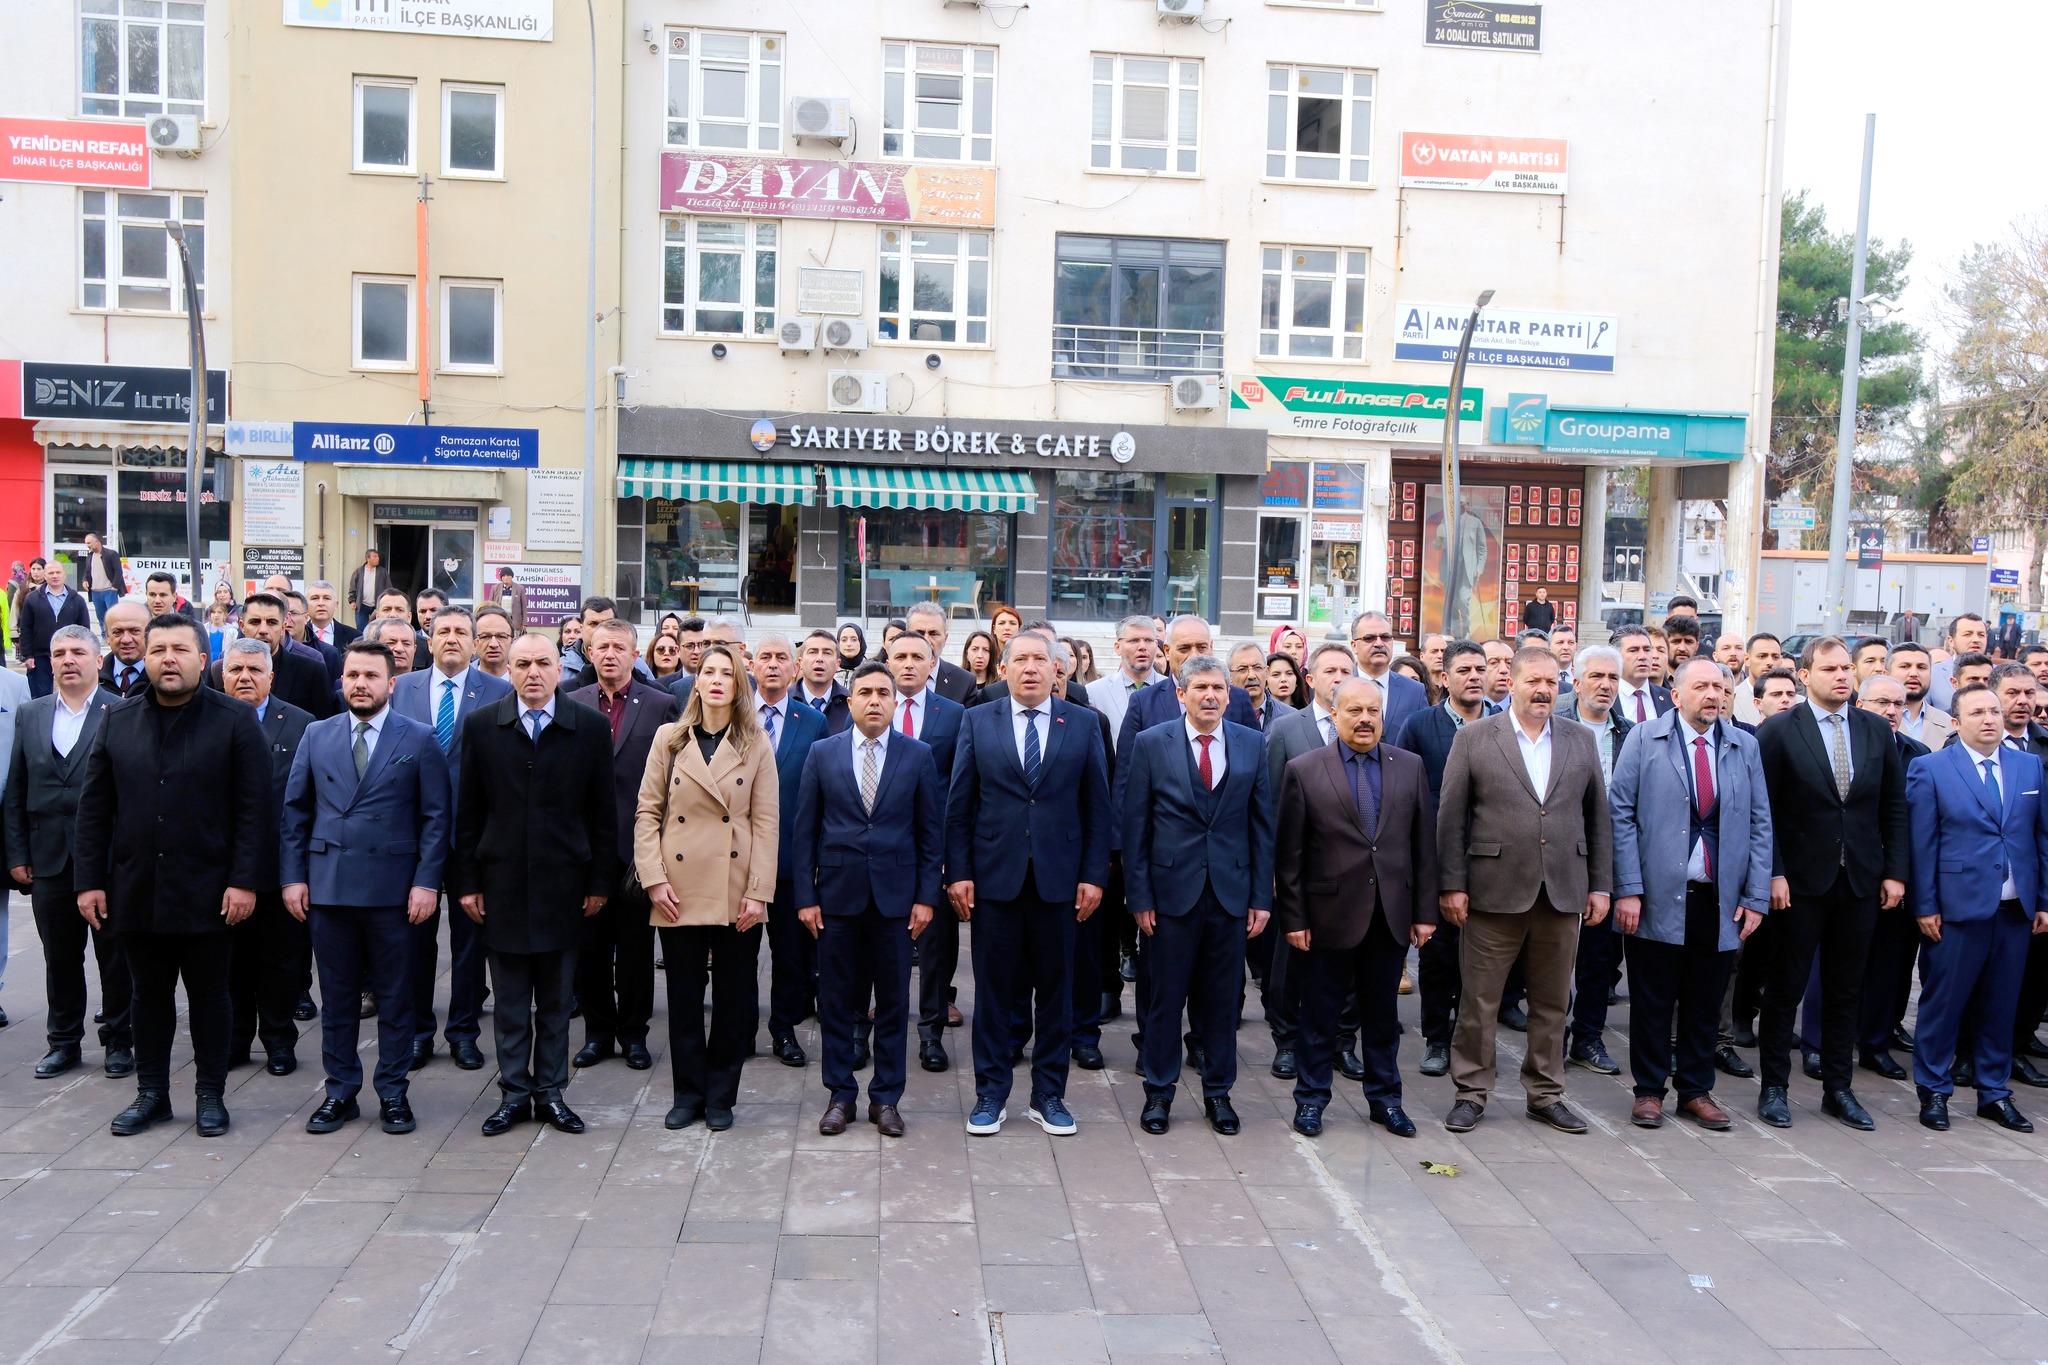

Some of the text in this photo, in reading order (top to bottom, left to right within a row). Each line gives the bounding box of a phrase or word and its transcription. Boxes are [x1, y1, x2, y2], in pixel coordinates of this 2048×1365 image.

[354, 16, 390, 25] PARTİ
[400, 8, 538, 31] İLÇE BAŞKANLIĞI
[1435, 28, 1534, 46] 24 ODALI OTEL SATILIKTIR
[9, 135, 144, 156] YENİDEN REFAH
[13, 154, 142, 172] DİNAR İLÇE BAŞKANLIĞI
[1438, 148, 1492, 164] VATAN
[676, 160, 894, 204] DAYAN
[1514, 172, 1538, 180] DİNAR
[1495, 180, 1558, 190] İLÇE BAŞKANLIĞI
[1403, 308, 1423, 331] A
[1529, 322, 1582, 338] PARTİ
[1518, 339, 1540, 347] Türkiye
[1442, 350, 1570, 366] DİNR İLÇE BAŞKANLIĞI
[35, 378, 127, 408] DENİZ
[1402, 393, 1475, 412] PLAA
[1293, 416, 1418, 436] Emre Fotoğrafçılık
[1559, 418, 1670, 442] Groupama
[312, 433, 370, 450] Allianz
[440, 435, 520, 447] Ramazan Kartal
[790, 424, 1100, 458] SARIYER BÖREK & CAFE
[434, 448, 520, 460] Sigorta Acenteliği
[267, 464, 300, 475] Ata
[140, 489, 172, 501] DENİZ
[1265, 496, 1299, 505] DIGITAL
[376, 507, 403, 516] OTEL
[1782, 510, 1812, 519] OTEL
[137, 560, 212, 570] DENİZ İLETİM
[537, 588, 569, 597] DANIŞMA
[537, 600, 576, 610] HİZMETLERİ
